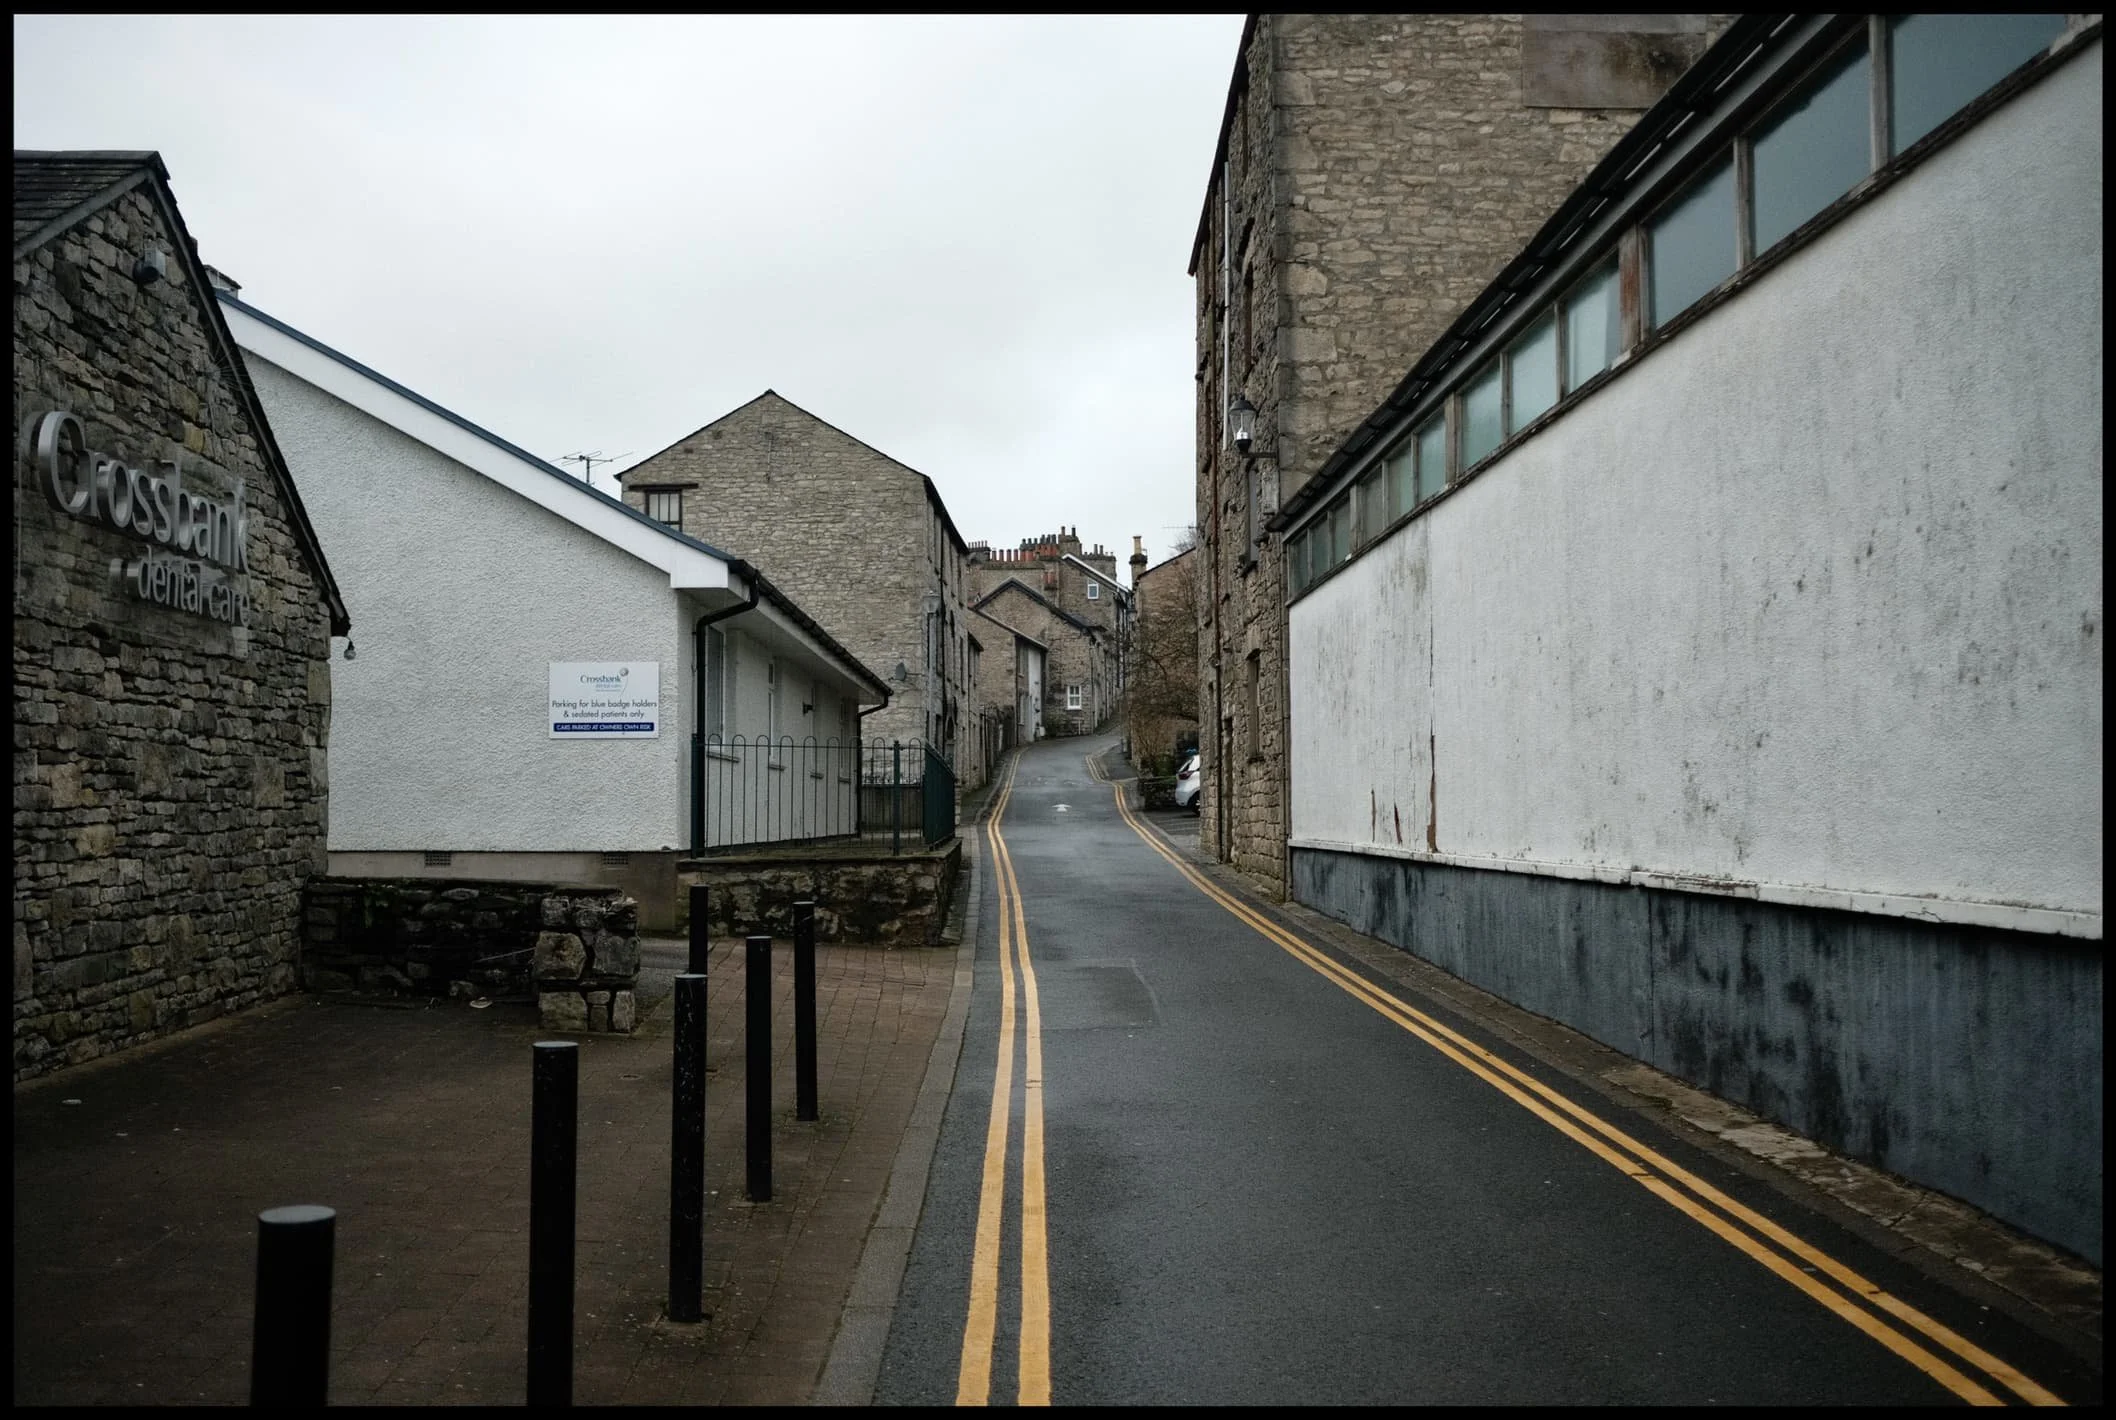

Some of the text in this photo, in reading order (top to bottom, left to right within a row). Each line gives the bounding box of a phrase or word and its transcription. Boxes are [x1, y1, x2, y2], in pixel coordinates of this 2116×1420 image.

[37, 411, 249, 574] Crossbank
[127, 544, 250, 627] dental care
[580, 674, 621, 683] Crossbank
[552, 699, 657, 709] Parking for blue badge holders
[564, 710, 644, 719] & sedated patients only
